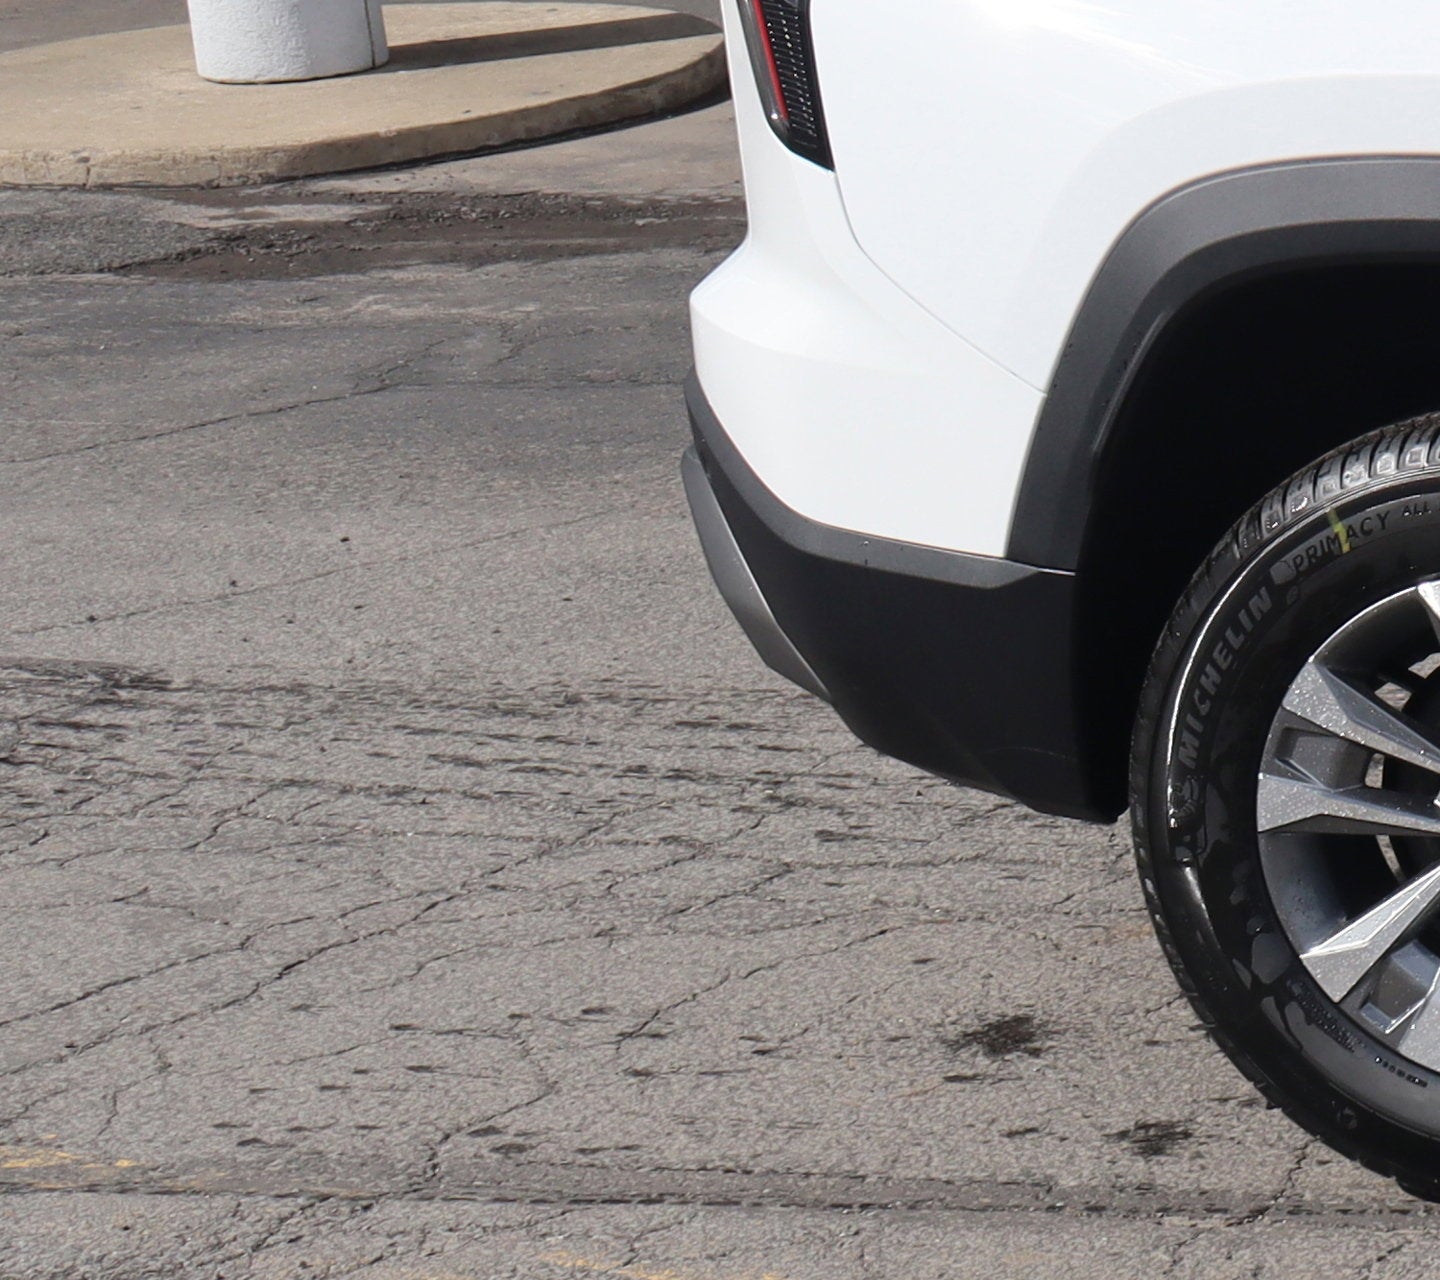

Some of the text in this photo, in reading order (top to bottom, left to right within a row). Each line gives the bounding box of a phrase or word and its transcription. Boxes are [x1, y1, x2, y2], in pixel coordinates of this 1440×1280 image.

[1178, 586, 1273, 769] MICHELIN
[1292, 510, 1390, 573] PRIMACY
[1402, 501, 1431, 516] ALL
